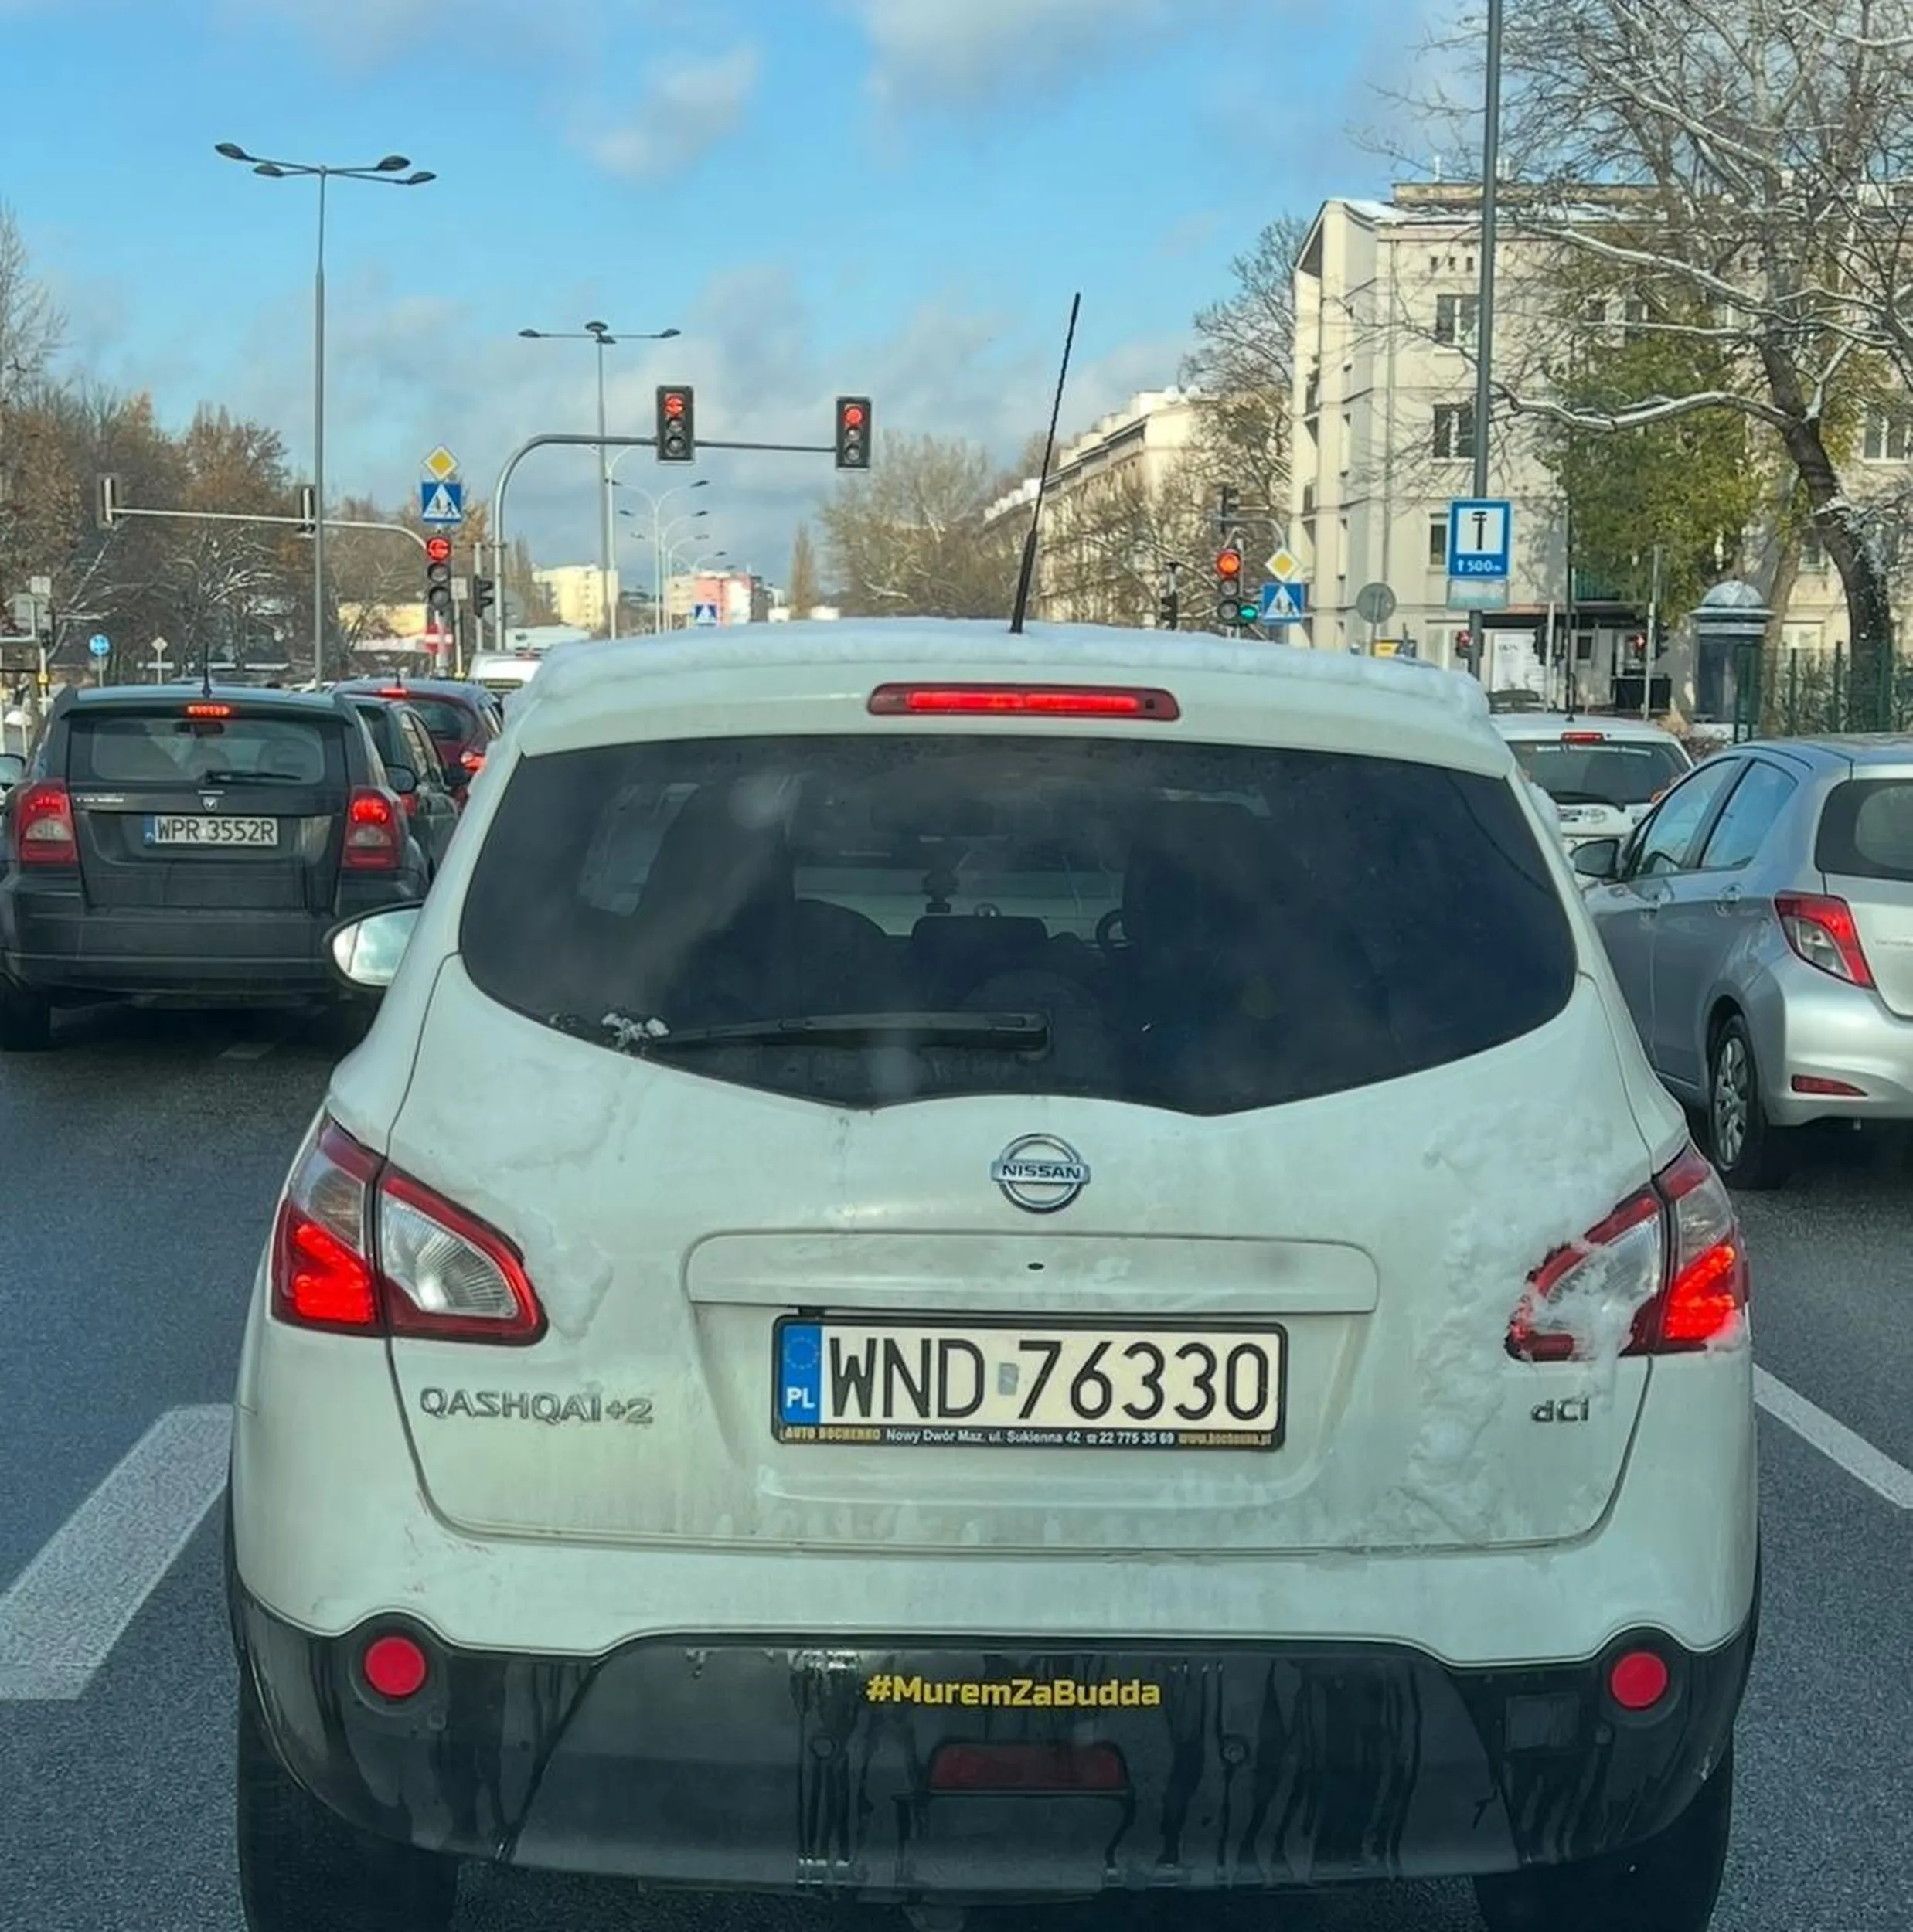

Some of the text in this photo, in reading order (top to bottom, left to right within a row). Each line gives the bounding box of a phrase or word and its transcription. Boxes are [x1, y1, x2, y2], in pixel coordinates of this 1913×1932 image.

[157, 818, 200, 841] WPR
[207, 820, 275, 842] 3552R
[1002, 1164, 1081, 1179] NISSAN
[829, 1336, 1269, 1420] WND 76330
[785, 1386, 815, 1410] PL
[785, 1425, 816, 1440] AUTO
[887, 1427, 921, 1444] Nowy
[923, 1428, 956, 1442] Dwór
[1006, 1430, 1064, 1444] Sukienna
[1065, 1430, 1081, 1444] 42
[1098, 1431, 1114, 1444] 22
[866, 1674, 1161, 1706] #MuremZaBudda
